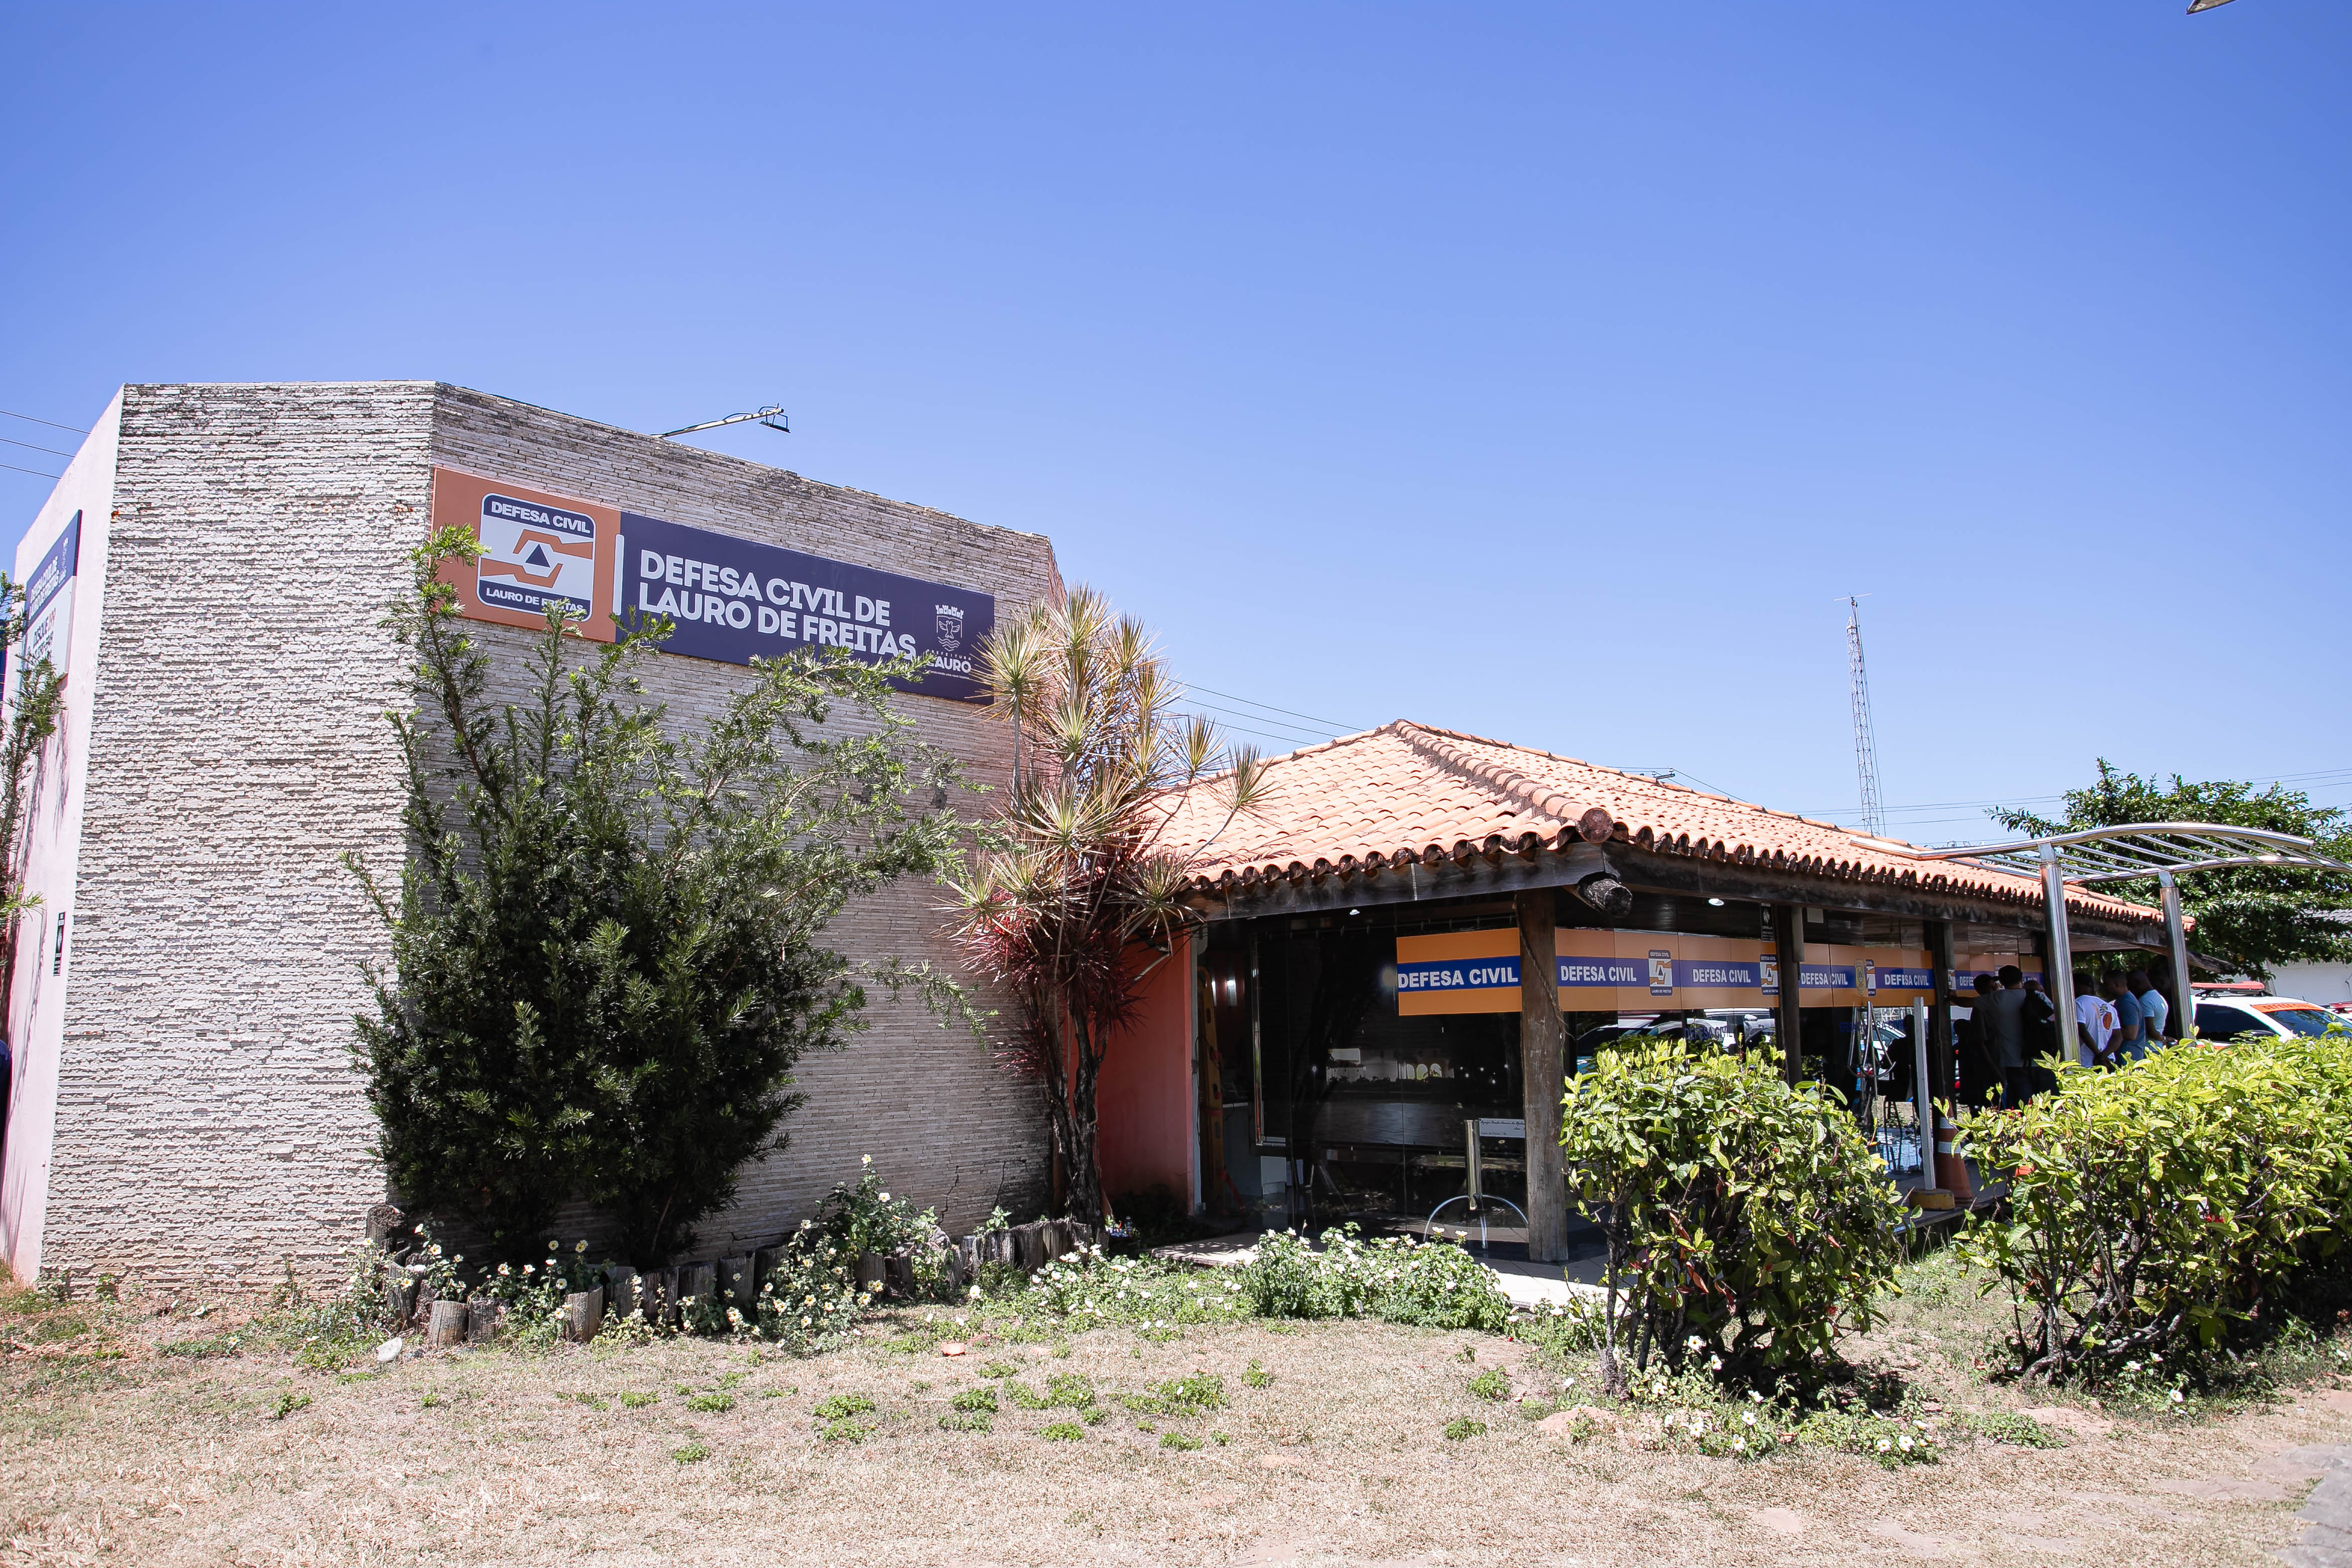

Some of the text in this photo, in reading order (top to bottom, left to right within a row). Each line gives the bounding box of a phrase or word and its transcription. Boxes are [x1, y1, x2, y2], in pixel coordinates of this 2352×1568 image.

[492, 501, 590, 534] DEFESA CIVIL
[640, 549, 890, 626] DEFESA CIVIL DE
[486, 588, 523, 602] LAURO
[525, 595, 540, 605] DE
[639, 582, 916, 660] LAURO DE FREITAS
[926, 649, 971, 661] PREFEITURA
[1398, 967, 1518, 988] DEFESA CIVIL
[1560, 966, 1637, 982] DEFESA CIVIL
[1693, 969, 1751, 983] DEFESA CIVIL
[1801, 972, 1848, 985] DEFESA CIVIL
[1885, 974, 1929, 986] DEFESA CIVIL
